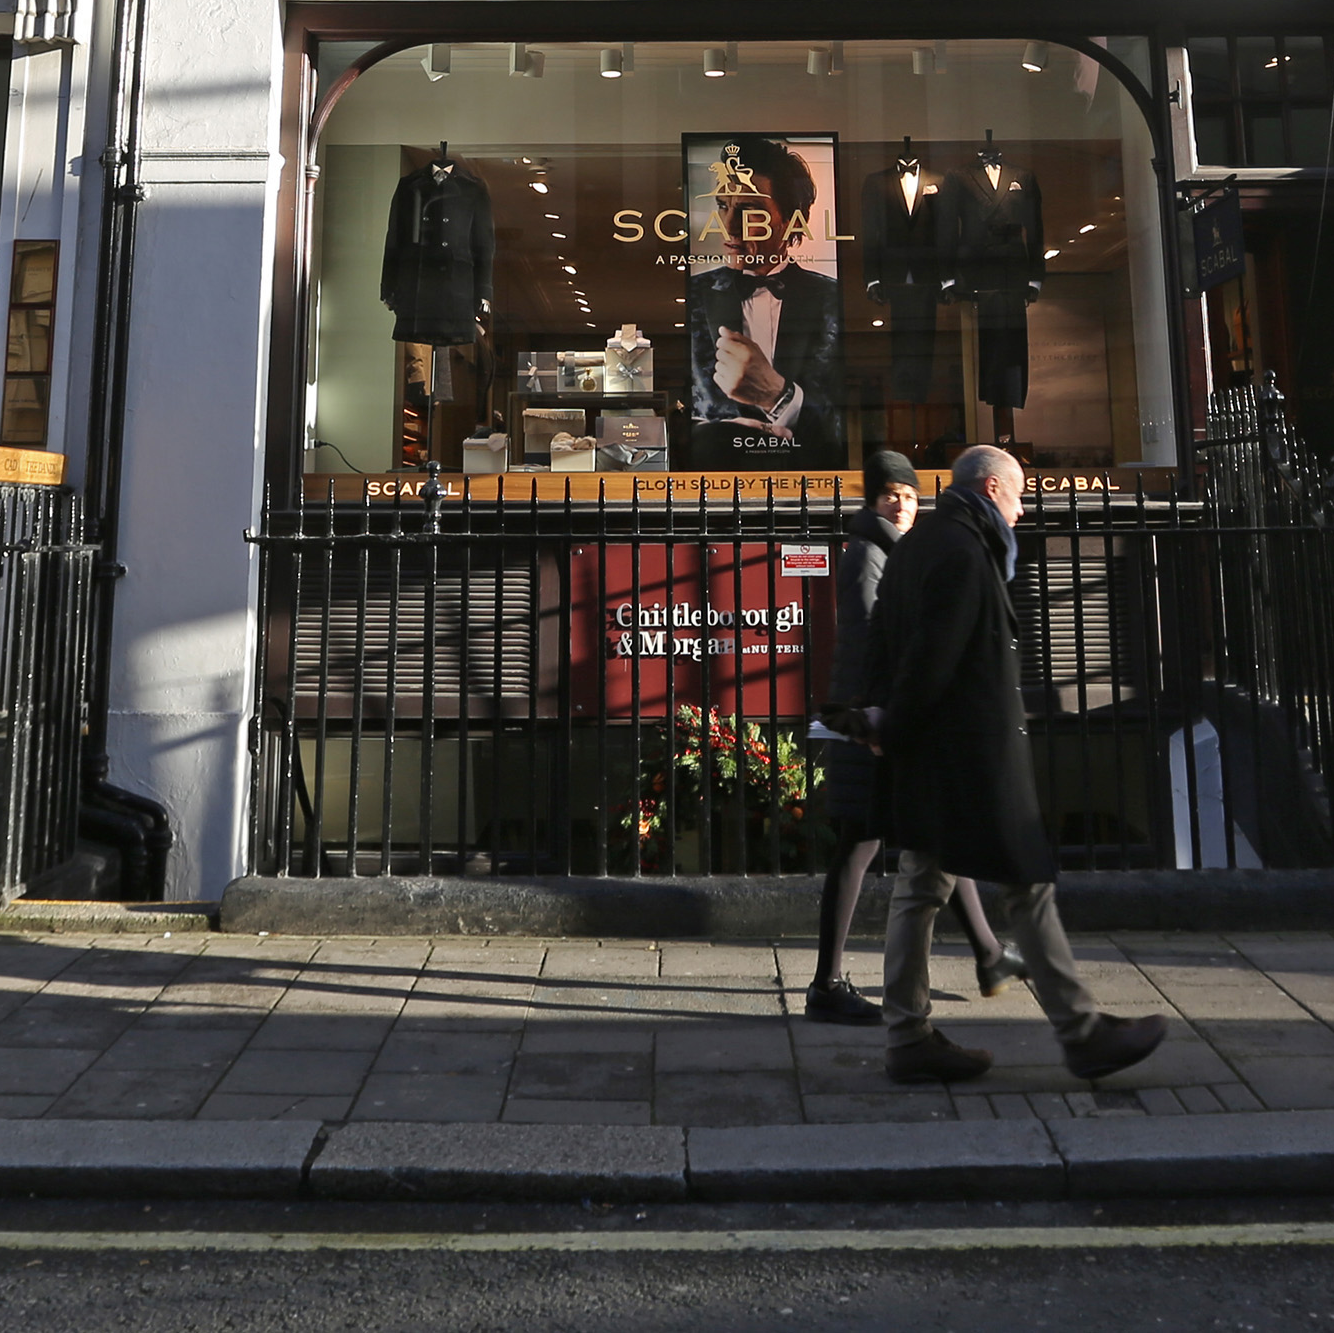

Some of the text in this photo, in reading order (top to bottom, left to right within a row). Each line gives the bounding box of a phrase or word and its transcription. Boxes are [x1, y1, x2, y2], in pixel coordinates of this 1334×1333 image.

[613, 209, 855, 243] SCABAL
[655, 254, 815, 265] A PASSION FOR CLOTH
[1201, 246, 1238, 277] SCABAL
[733, 437, 801, 447] SCABAL
[4, 458, 18, 472] CAD
[25, 460, 38, 474] THE
[367, 482, 461, 496] SCAL
[636, 478, 843, 490] CLOTH SOLD BY THE METRE
[1026, 475, 1120, 491] SCABAL
[617, 602, 804, 632] Chittleborough
[617, 631, 633, 656] &
[640, 631, 736, 662] Morgan
[752, 645, 805, 654] NUTERS
